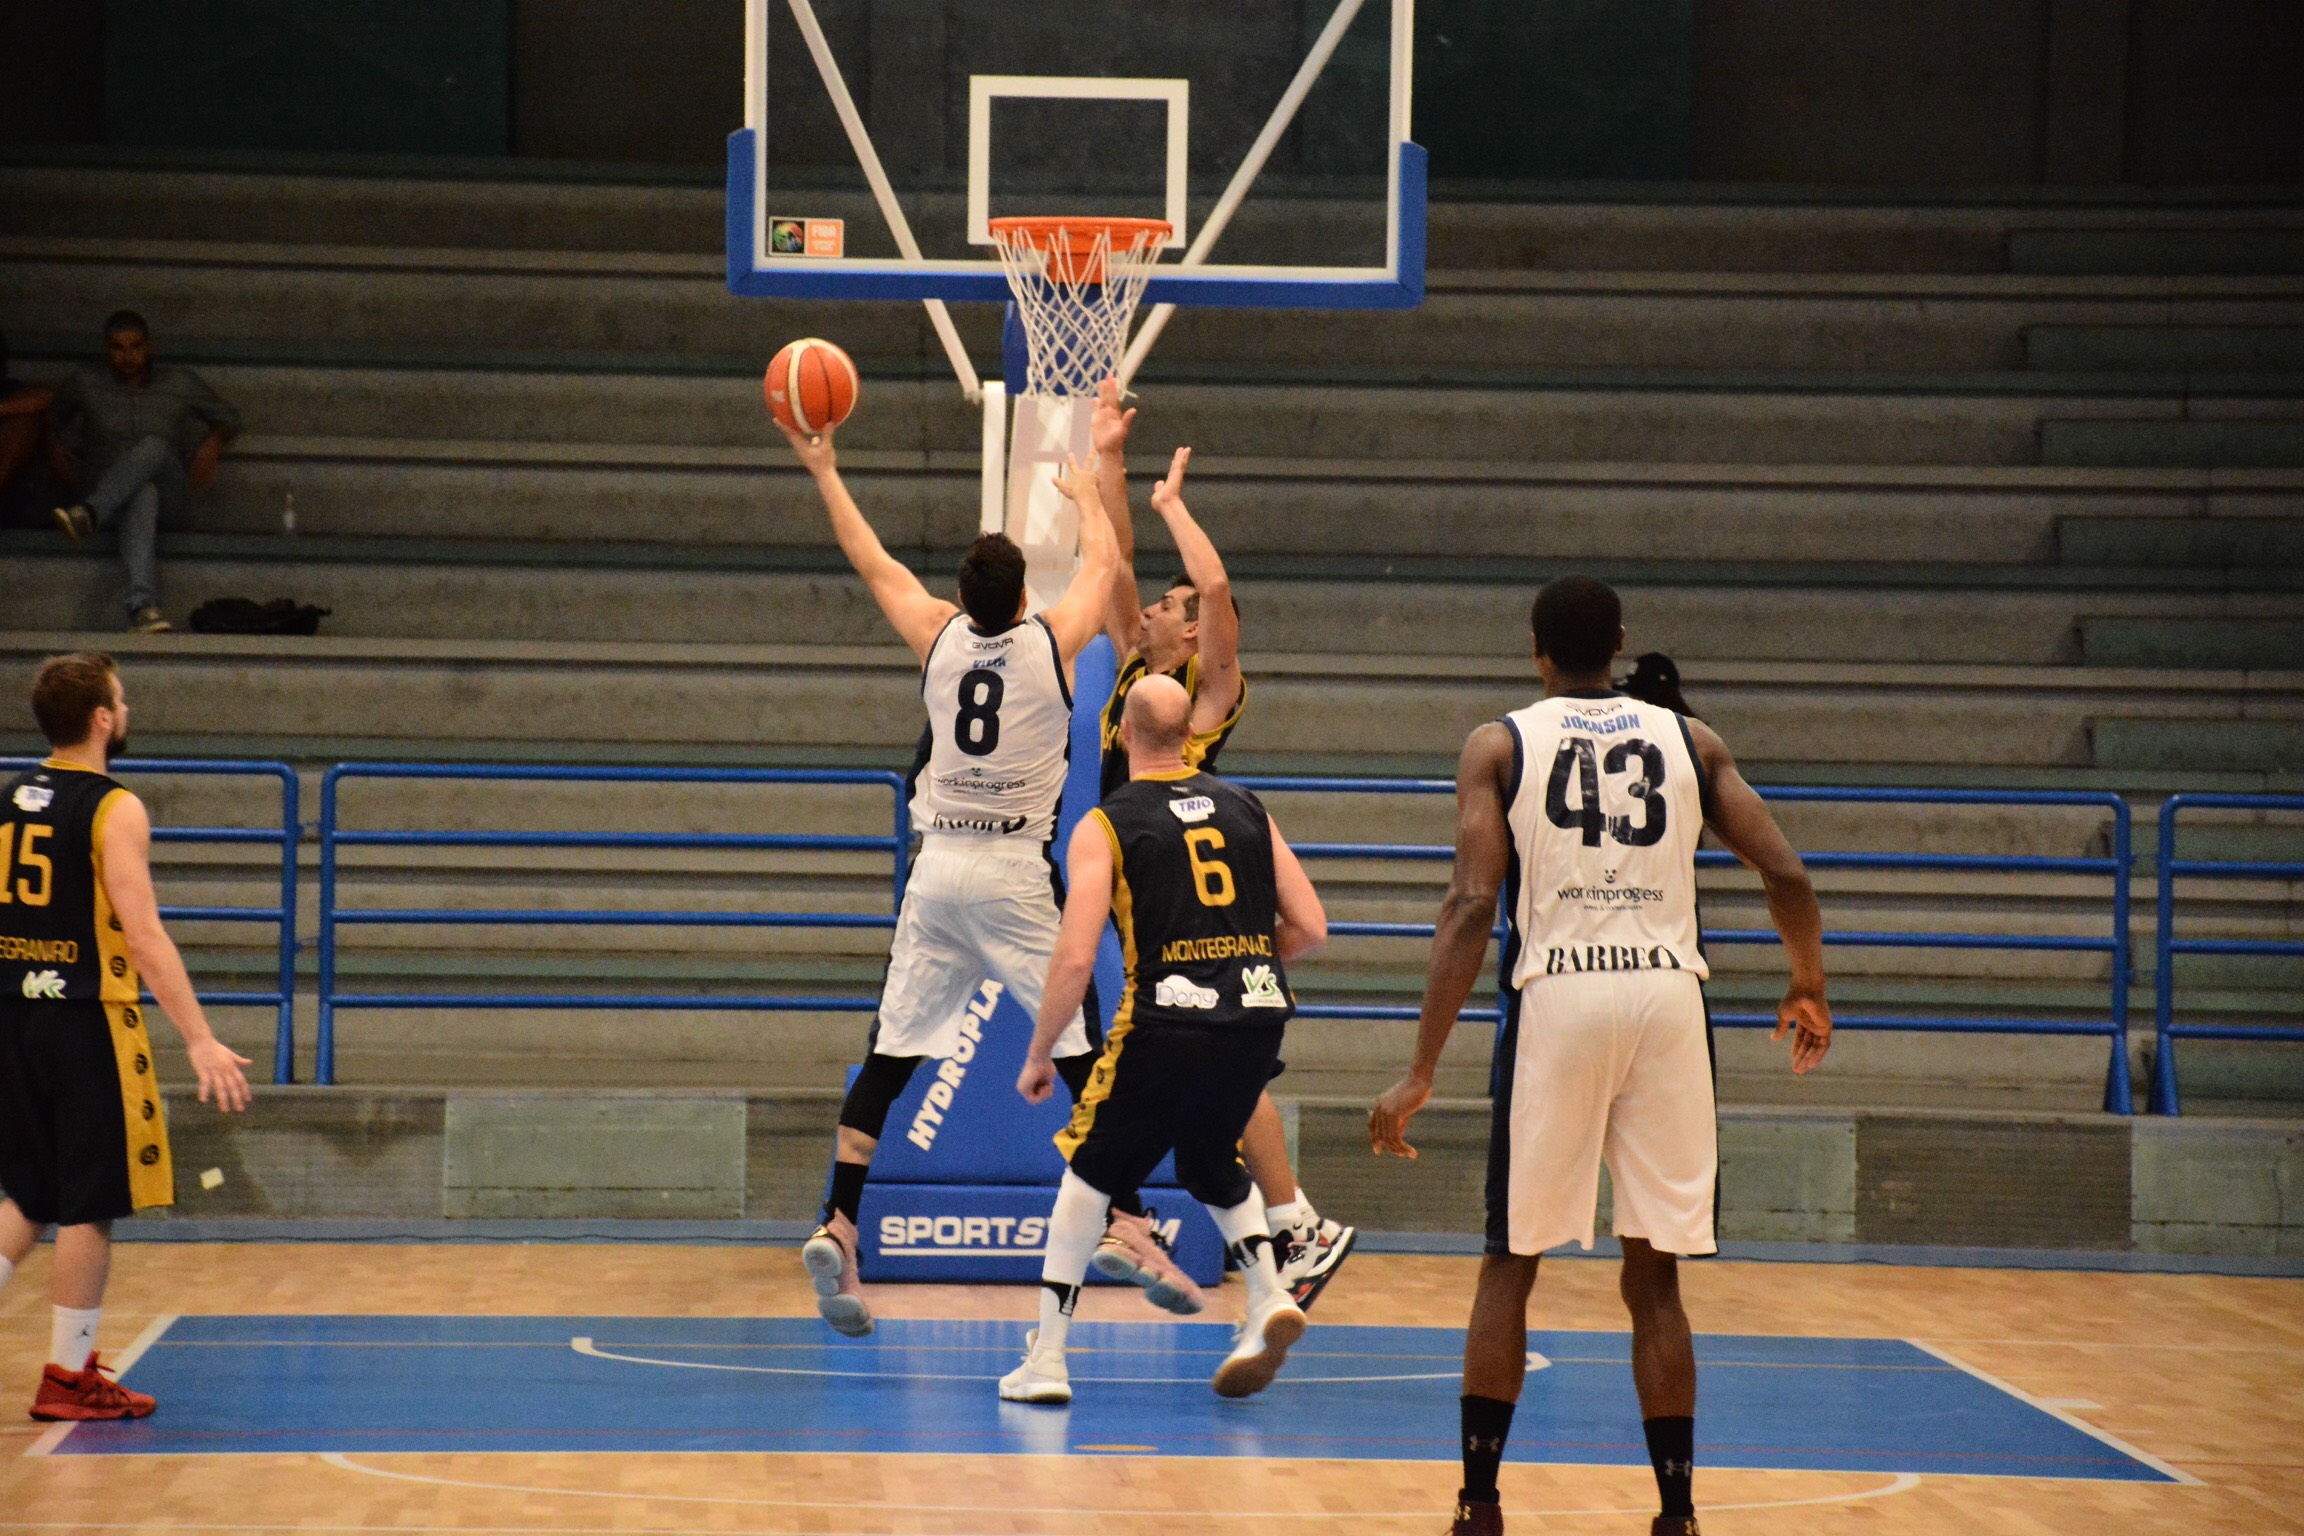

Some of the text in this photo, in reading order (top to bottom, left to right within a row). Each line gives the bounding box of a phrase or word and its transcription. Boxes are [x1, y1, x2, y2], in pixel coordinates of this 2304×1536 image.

[955, 669, 1004, 756] 8
[1179, 799, 1211, 812] TRIO
[1545, 737, 1666, 848] 43
[0, 821, 54, 907] 15
[1184, 826, 1236, 907] 6
[1557, 886, 1665, 904] workinprogess
[907, 978, 1004, 1152] HYDROPLA
[879, 1215, 1182, 1247] SPORTSM
